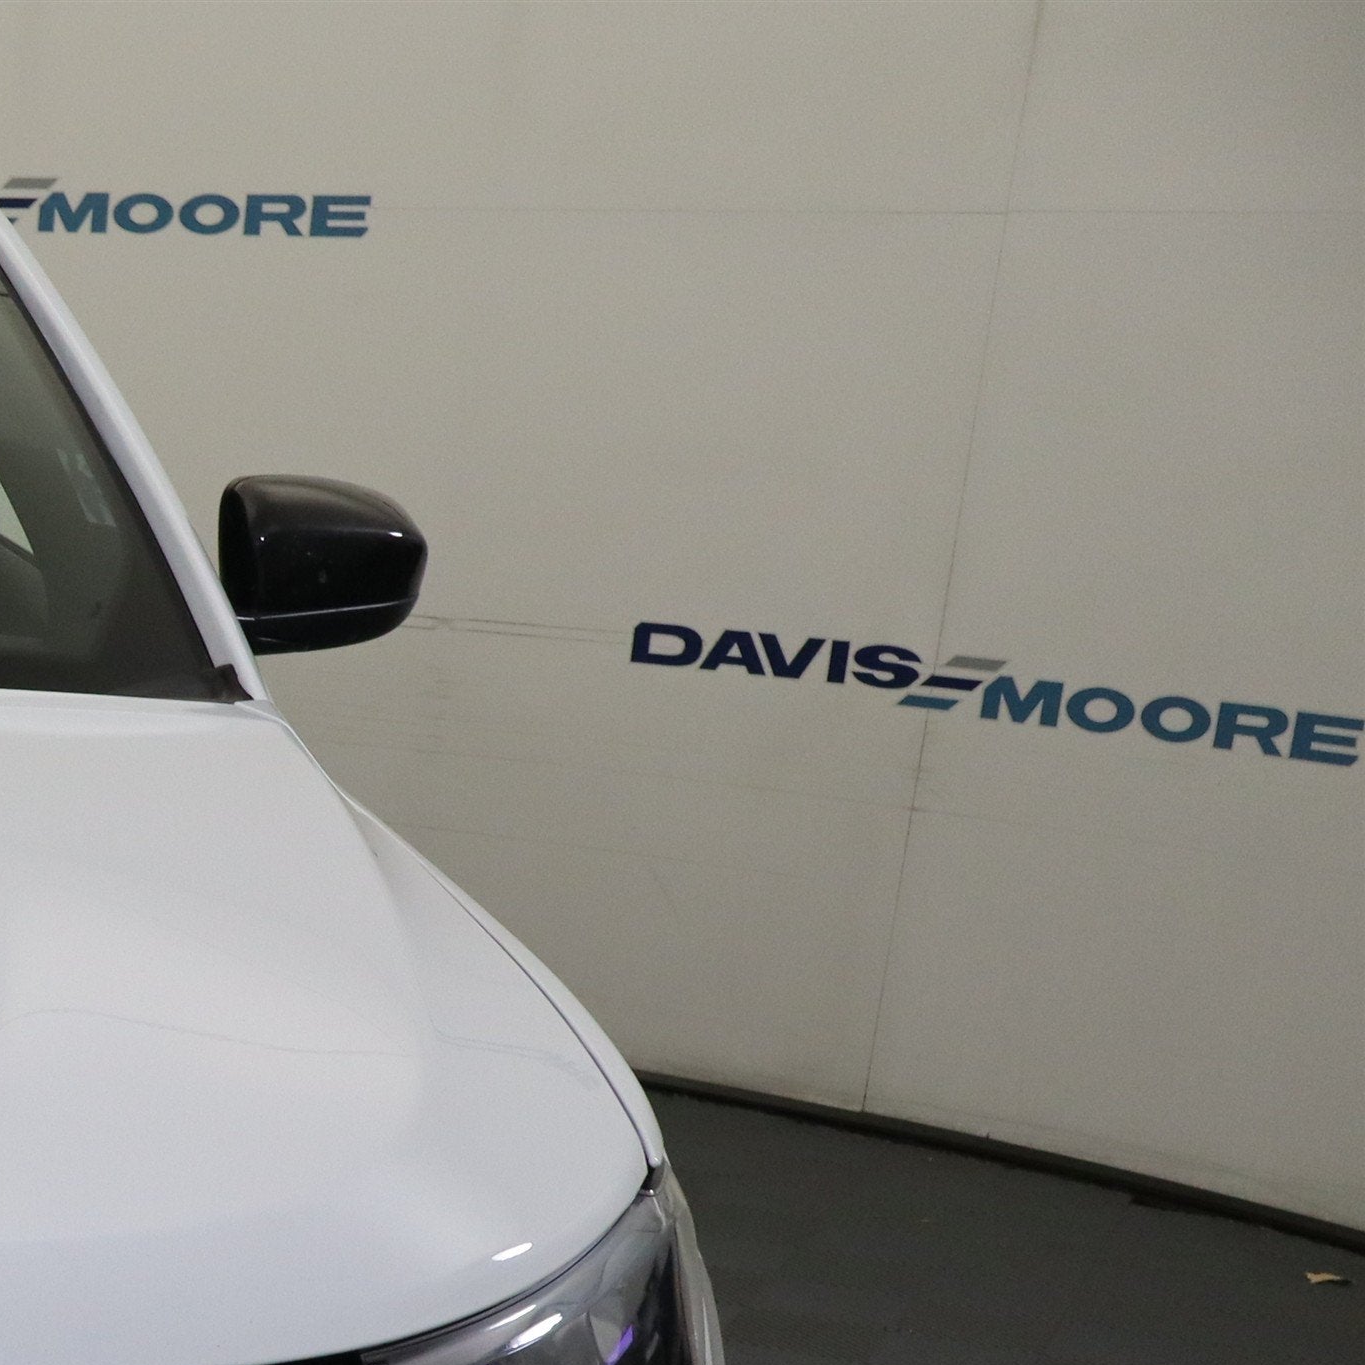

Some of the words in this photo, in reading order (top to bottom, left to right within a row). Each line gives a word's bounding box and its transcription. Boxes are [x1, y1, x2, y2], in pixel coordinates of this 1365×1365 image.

[37, 190, 372, 239] MOORE
[629, 621, 924, 690] DAVIS
[980, 676, 1365, 768] MOORE
